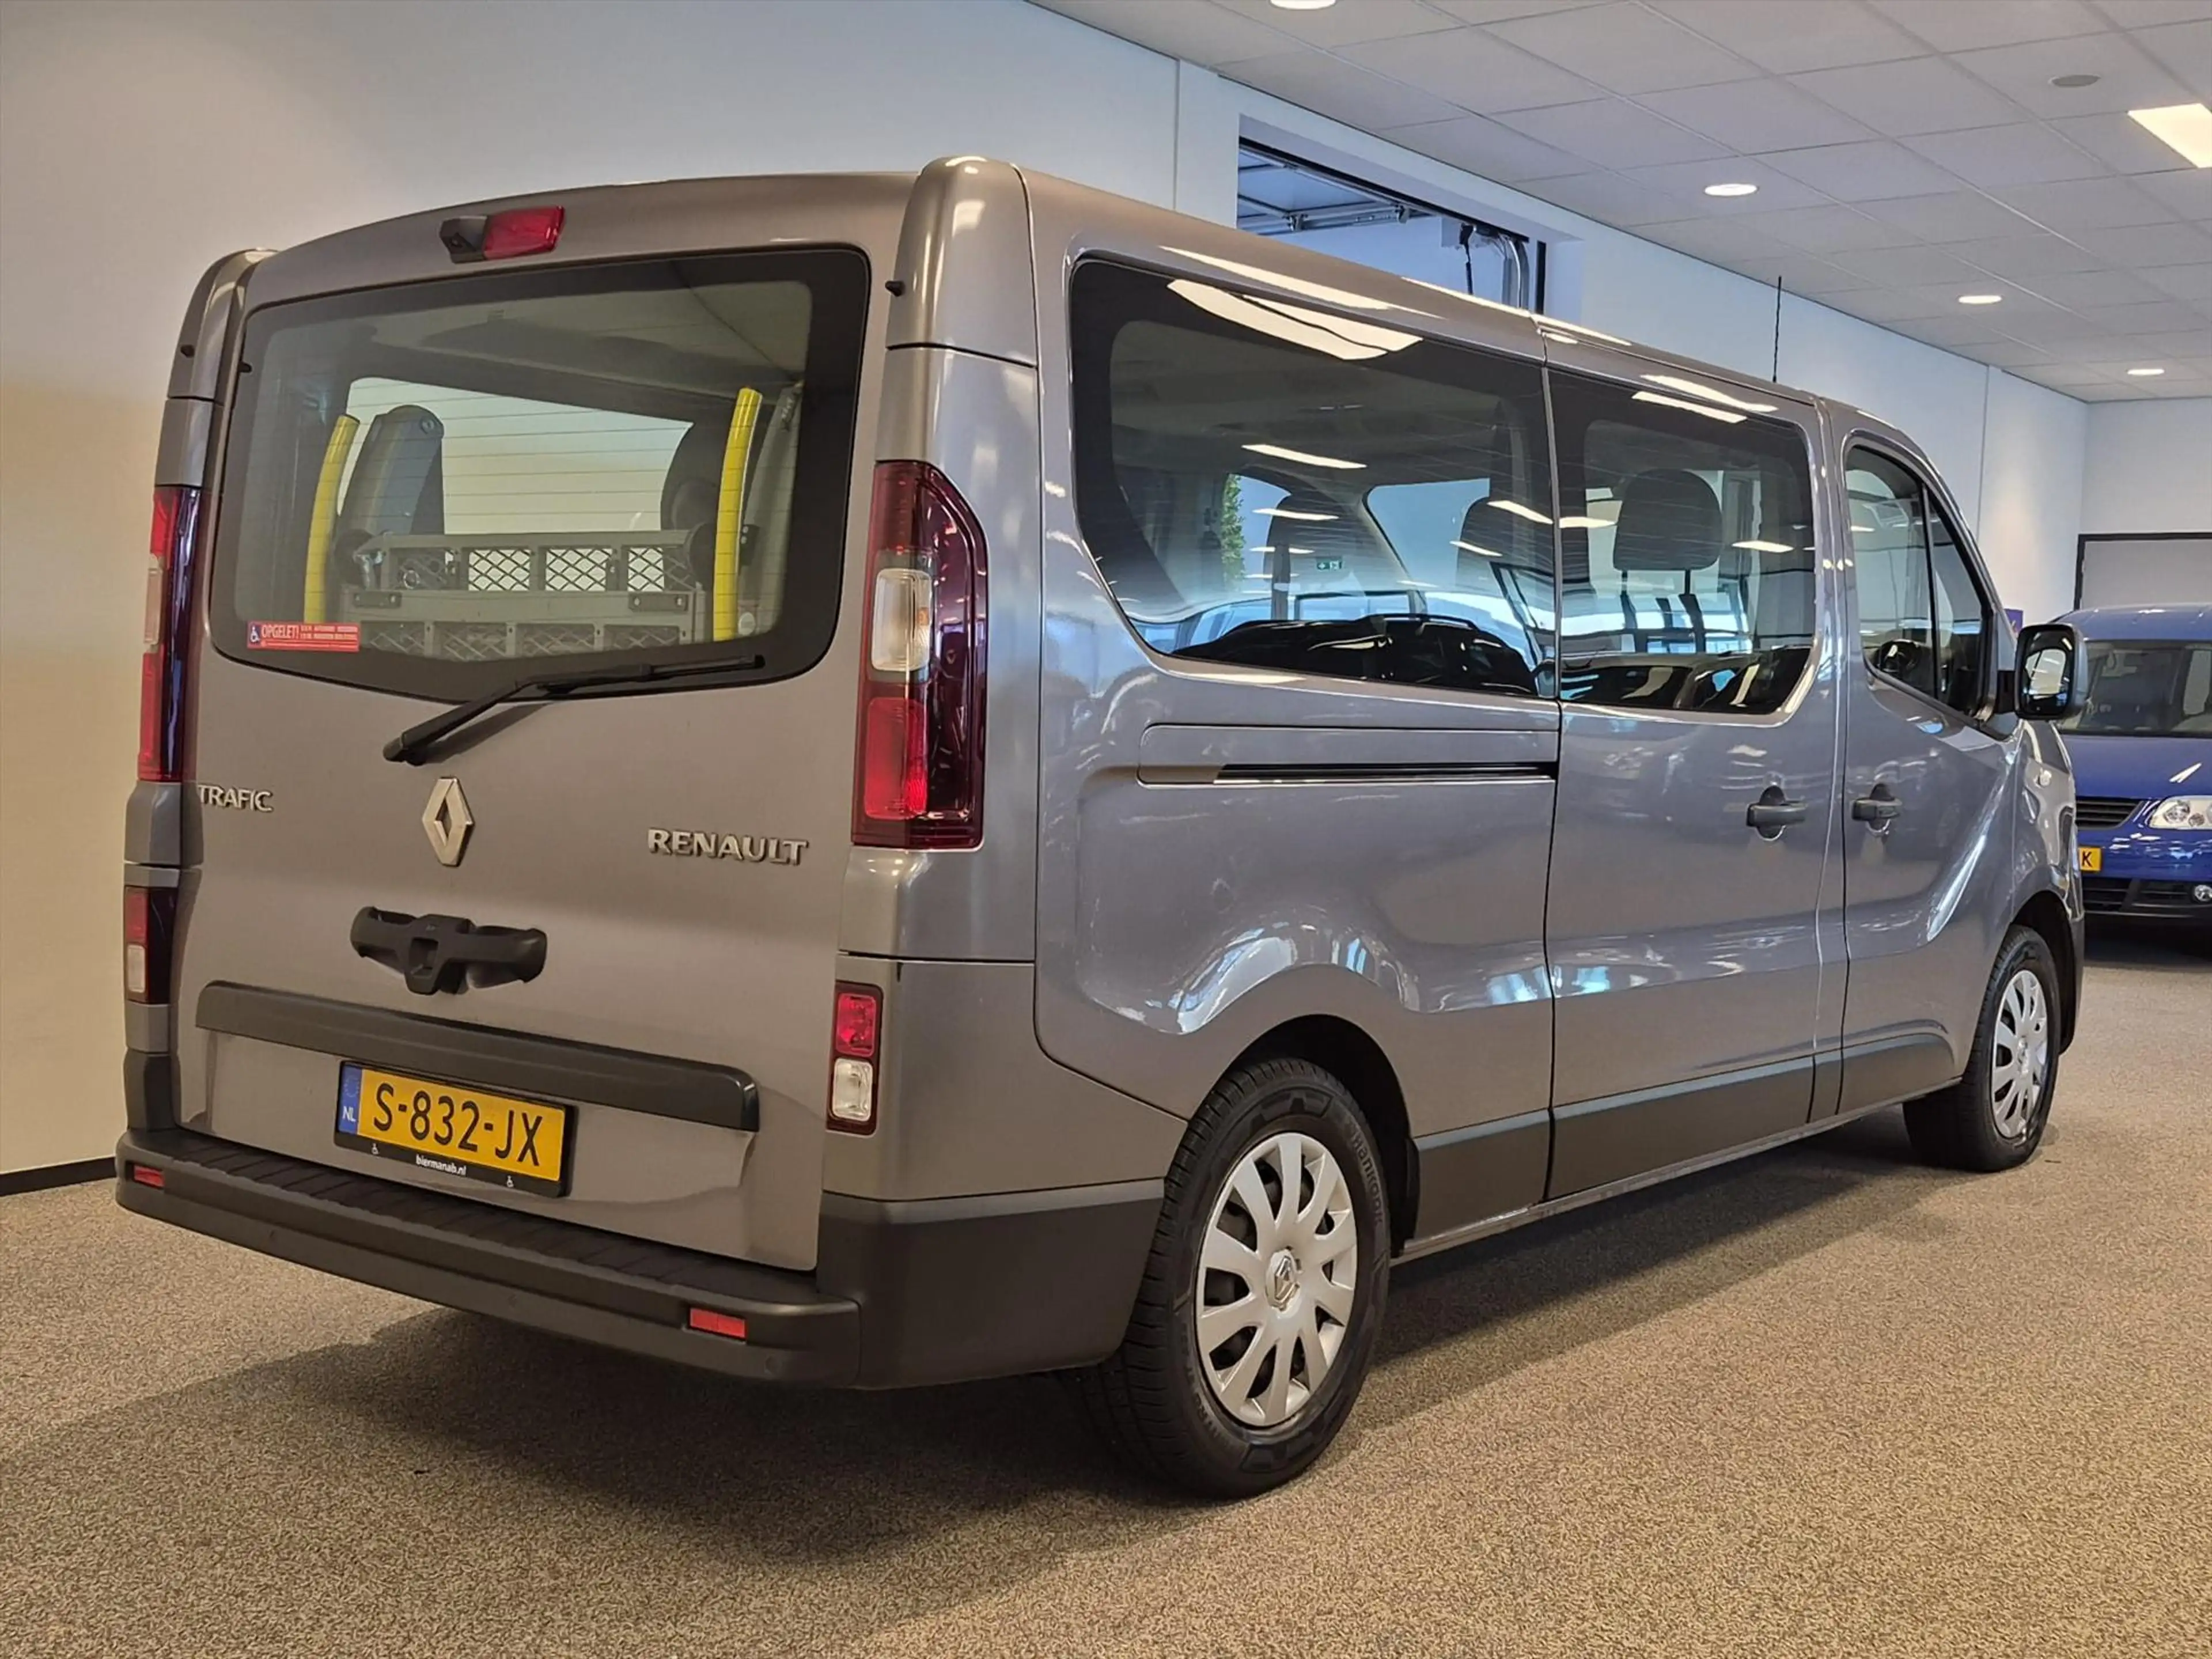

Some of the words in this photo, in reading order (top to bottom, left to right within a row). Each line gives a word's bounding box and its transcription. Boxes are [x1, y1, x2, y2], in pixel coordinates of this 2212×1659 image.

[198, 784, 274, 812] TRAFIC
[647, 827, 809, 866] RENAULT
[342, 1106, 356, 1123] NL
[373, 1082, 543, 1166] S-832-JX
[416, 1154, 467, 1176] biermanab.nl
